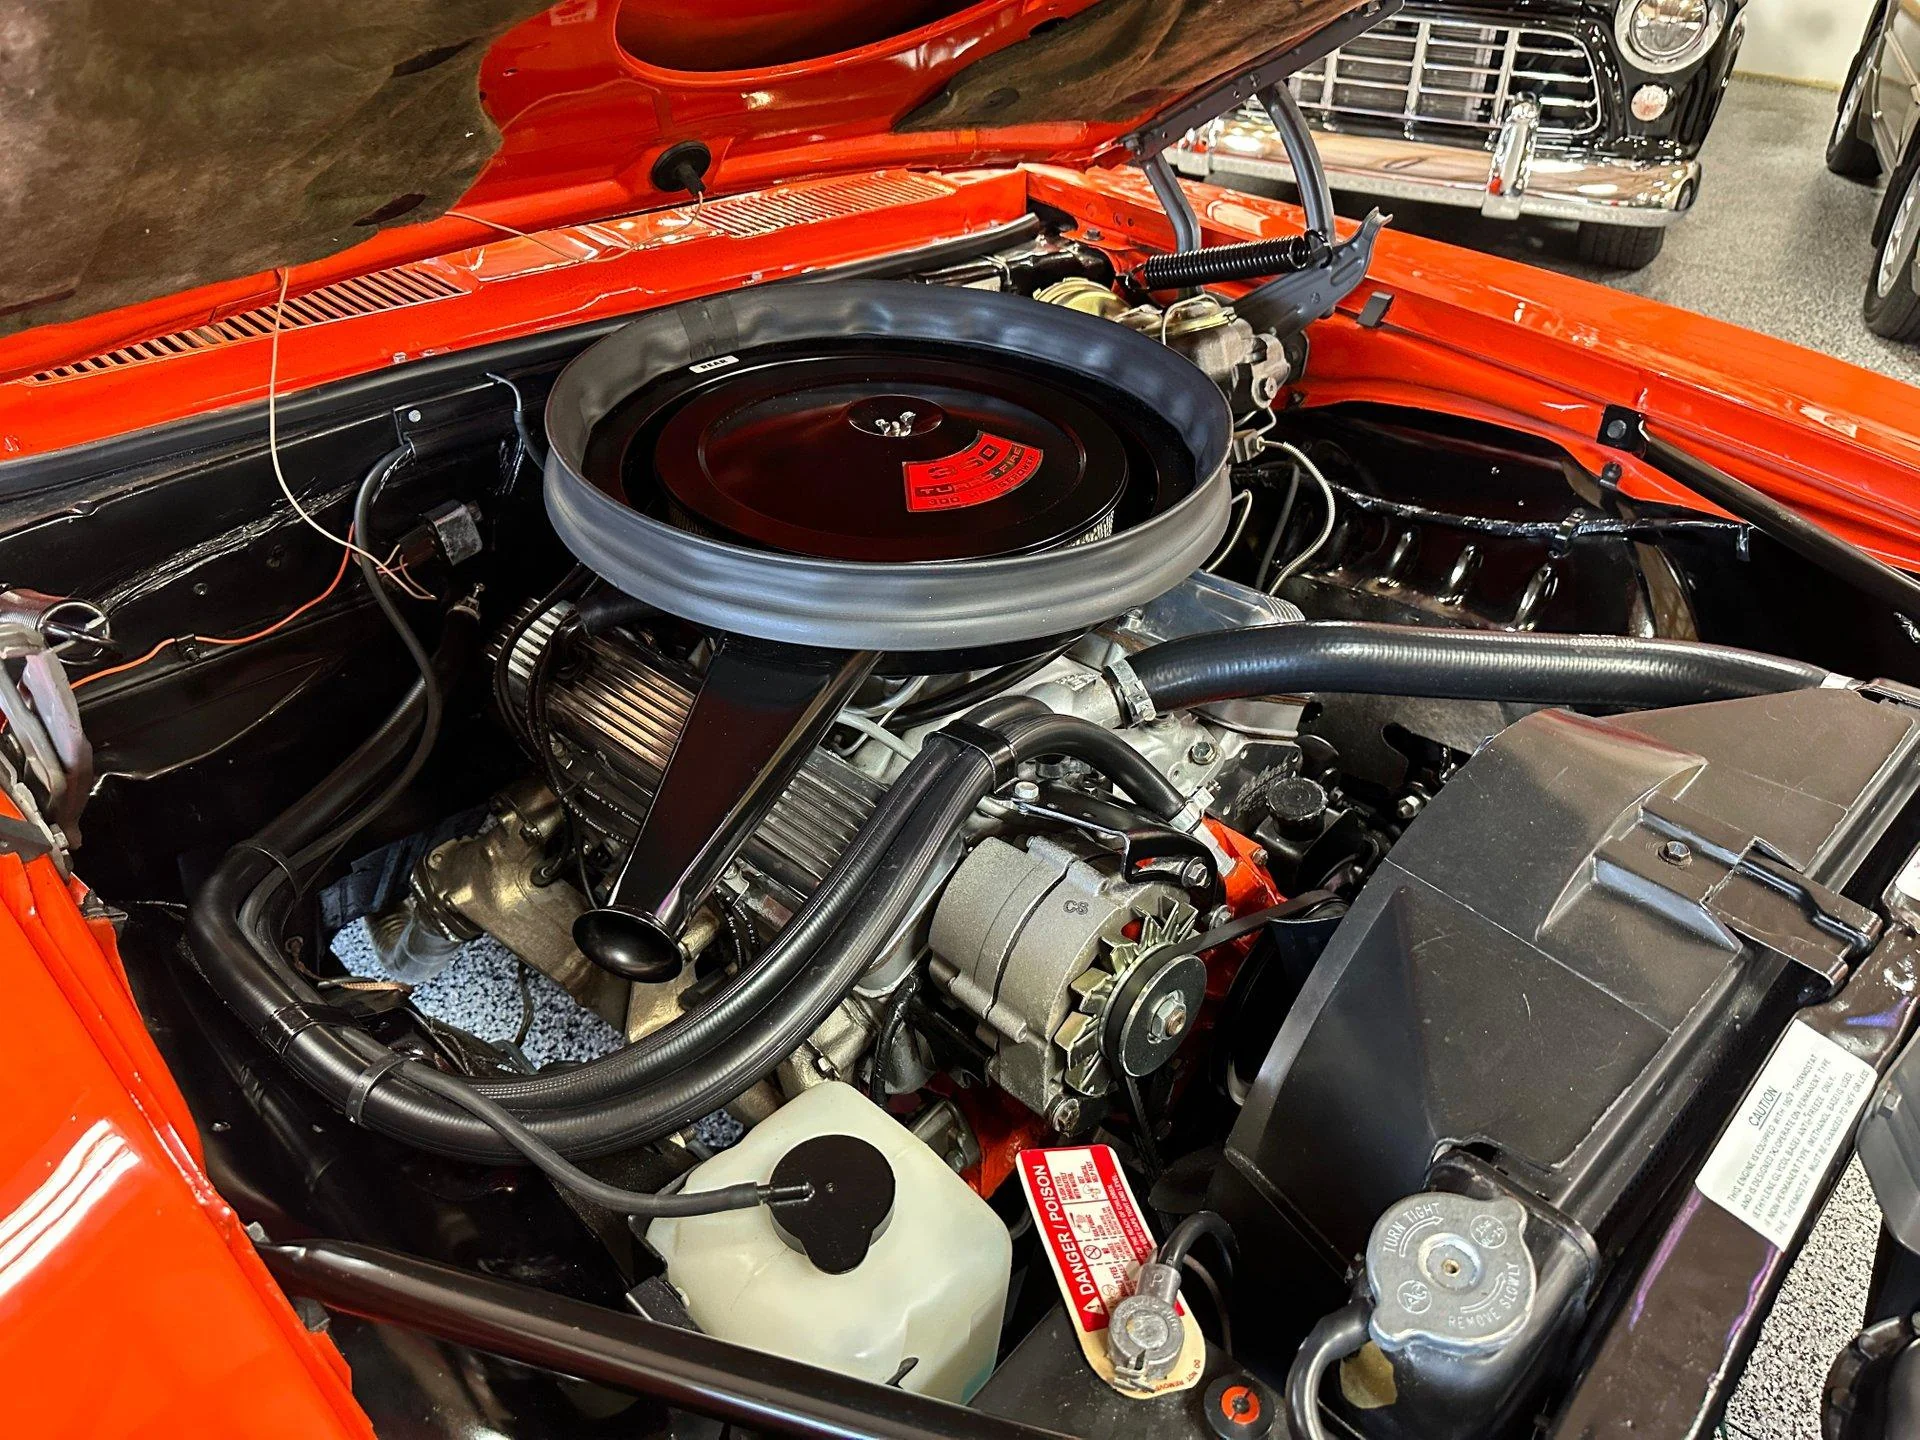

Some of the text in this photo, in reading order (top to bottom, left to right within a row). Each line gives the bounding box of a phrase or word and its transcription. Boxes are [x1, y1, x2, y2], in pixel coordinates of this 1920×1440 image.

[1791, 1053, 1818, 1091] THERMOSTAT
[1746, 1084, 1779, 1128] CAUTION
[1796, 1073, 1821, 1110] PERMANENT
[1772, 1107, 1785, 1124] WITH
[1789, 1108, 1801, 1121] ON
[1753, 1123, 1776, 1155] EQUIPPED
[1774, 1118, 1795, 1148] OPERATE
[1736, 1159, 1755, 1186] ENGINE
[1750, 1152, 1759, 1162] IS
[1751, 1154, 1774, 1187] DESIGNED
[1770, 1154, 1790, 1183] GLYCOL
[1747, 1185, 1756, 1195] IS
[1774, 1162, 1801, 1204] PERMANENT
[1795, 1146, 1810, 1165] TYPE
[1774, 1218, 1787, 1236] THE
[1782, 1173, 1812, 1219] THERMOSTAT
[1807, 1153, 1822, 1173] MUST
[1822, 1114, 1843, 1146] CHANGED
[1029, 1164, 1065, 1221] POISON
[1726, 1184, 1741, 1203] THIS
[1739, 1192, 1752, 1210] AND
[1382, 1202, 1440, 1253] TURN TIGHT
[1056, 1231, 1095, 1295] DANGER
[1448, 1262, 1520, 1329] REMOVE SLOWLY
